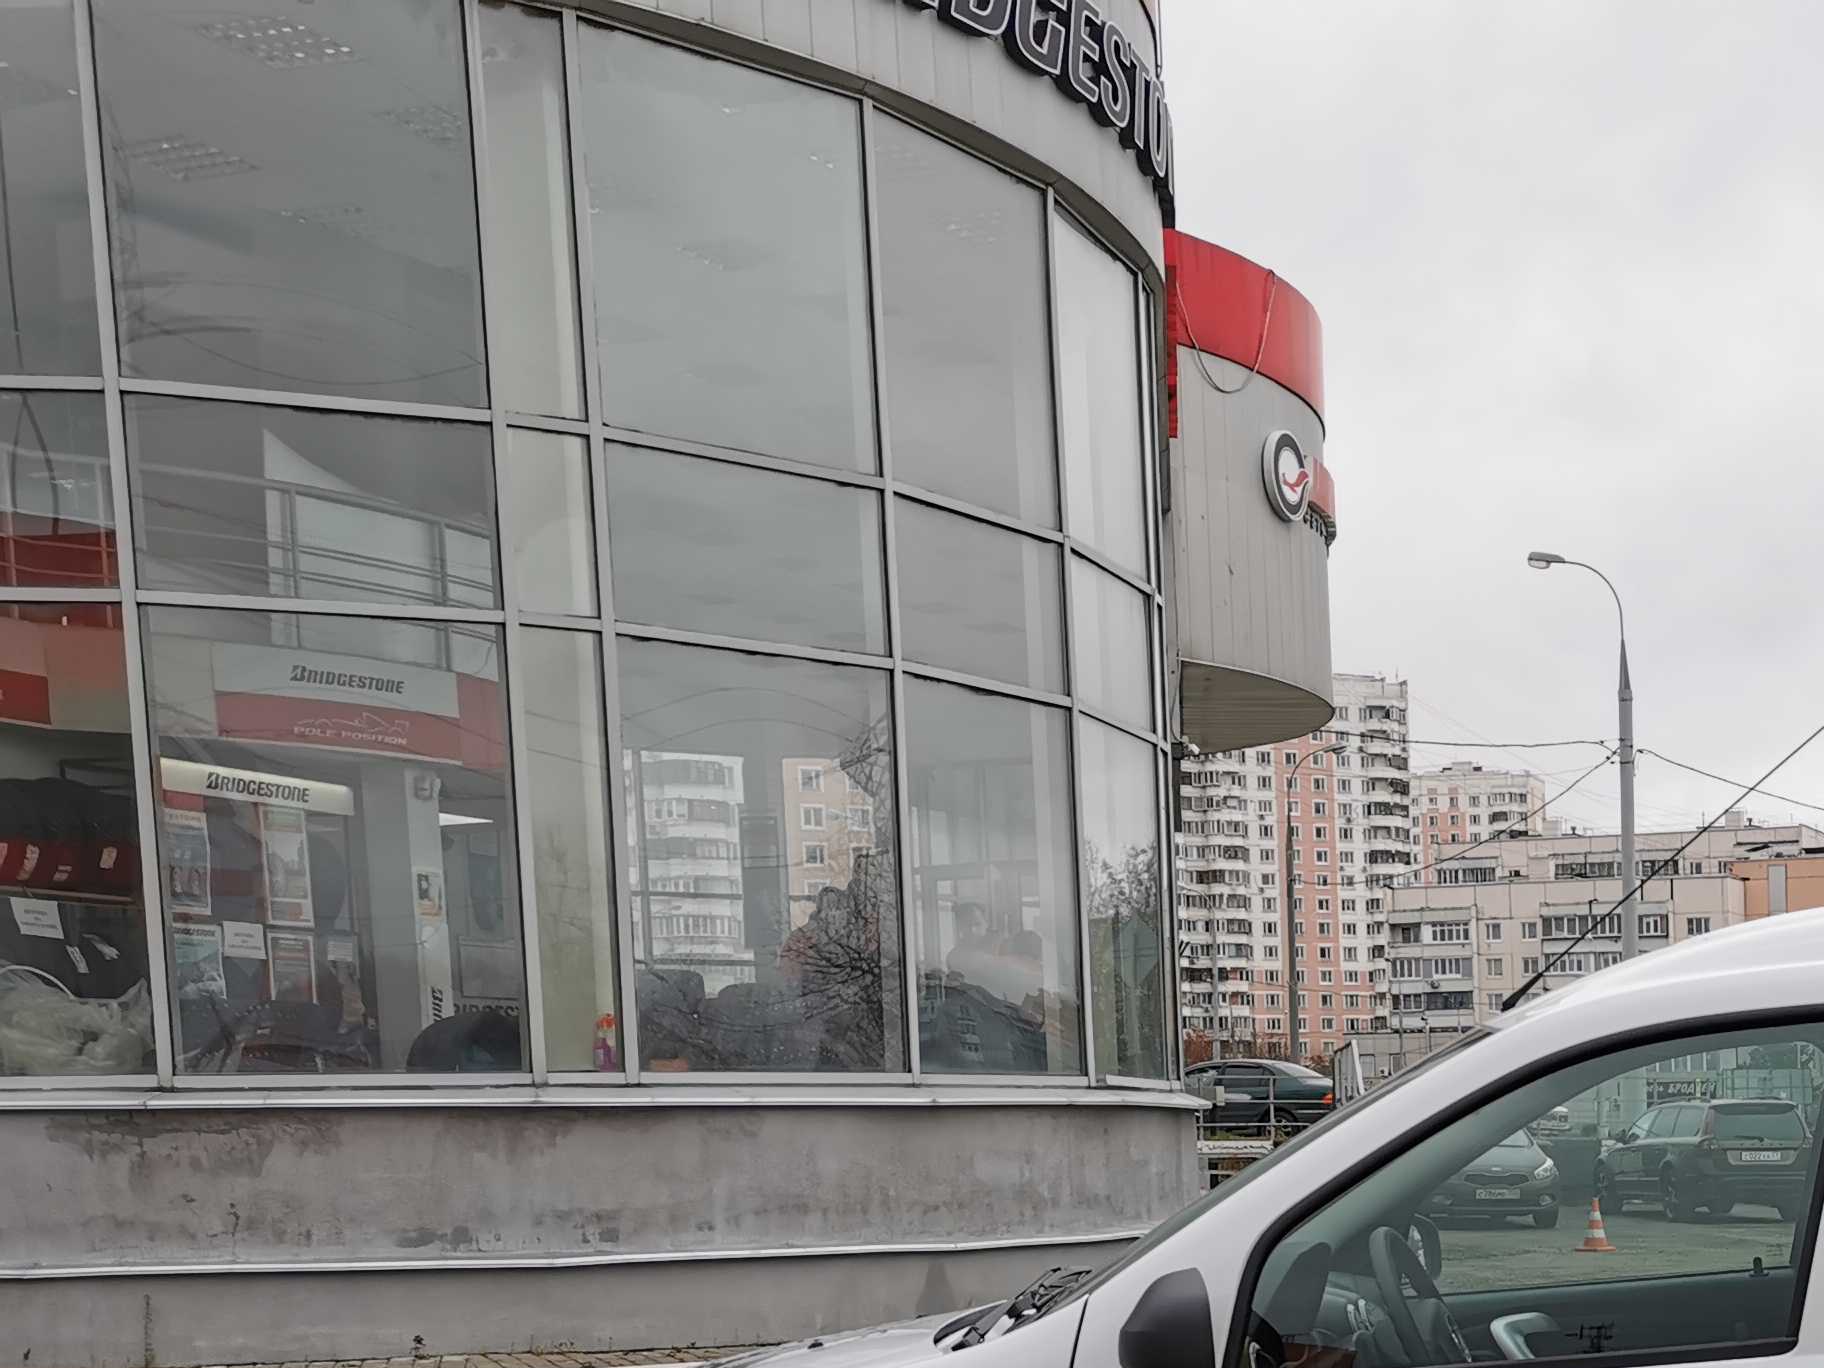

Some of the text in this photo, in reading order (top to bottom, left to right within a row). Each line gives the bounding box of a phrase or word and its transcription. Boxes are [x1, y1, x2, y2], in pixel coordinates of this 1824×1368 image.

[290, 664, 405, 695] BRIDGESTONE
[293, 726, 407, 746] POLE POSITION
[206, 771, 310, 804] BRIDGESTONE
[1667, 1081, 1716, 1095] БРОДЕЙ
